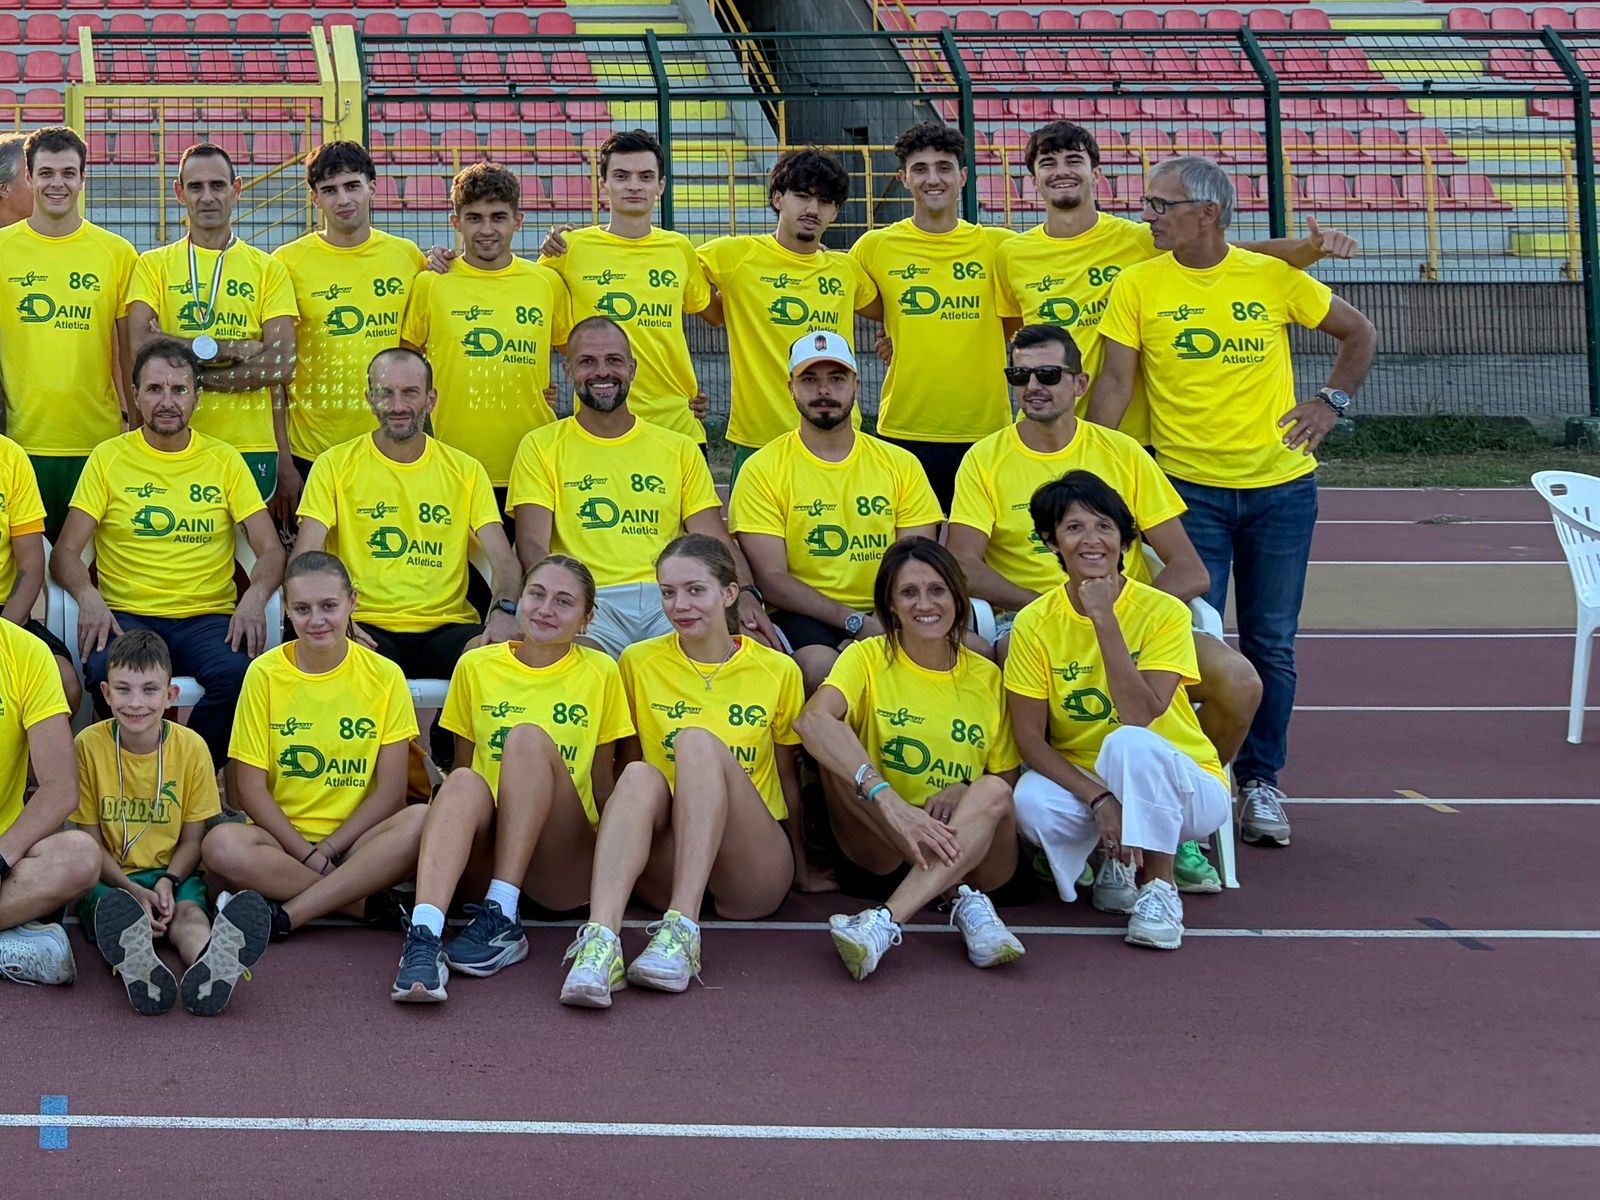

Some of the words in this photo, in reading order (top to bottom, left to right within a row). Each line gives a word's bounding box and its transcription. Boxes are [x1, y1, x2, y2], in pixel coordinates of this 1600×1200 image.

[69, 272, 99, 290] 80
[649, 269, 677, 287] 80
[953, 262, 983, 280] 80
[227, 279, 254, 297] 80
[373, 277, 403, 297] 80
[818, 276, 842, 295] 80
[16, 293, 91, 322] DAINI
[594, 292, 672, 321] DAINI
[898, 286, 980, 315] DAINI
[324, 306, 398, 336] DAINI
[516, 306, 543, 324] 80
[768, 296, 838, 326] DAINI
[940, 310, 980, 320] Atletica
[1037, 297, 1108, 327] DAIN
[1232, 302, 1266, 321] 80
[54, 321, 89, 330] Atletica
[637, 318, 672, 327] Atletica
[1077, 316, 1101, 327] Atlet
[365, 328, 398, 338] Atletica
[461, 328, 537, 357] DAINI
[1171, 328, 1264, 359] DAINI
[1222, 355, 1265, 364] Atletica
[189, 484, 221, 502] 80
[631, 474, 664, 492] 80
[419, 502, 450, 524] 80
[577, 497, 659, 529] DAINI
[856, 496, 890, 516] 80
[131, 505, 214, 536] DAINI
[621, 526, 658, 535] Atletica
[173, 534, 212, 543] Atletica
[367, 527, 443, 558] DAINI
[804, 525, 888, 556] DAINI
[406, 557, 442, 568] Atletica
[553, 703, 587, 725] 80
[729, 704, 766, 726] 80
[339, 717, 376, 740] 80
[951, 718, 984, 744] 80
[277, 745, 366, 778] DAINI
[881, 736, 972, 779] DAINI
[324, 777, 365, 788] Atletica
